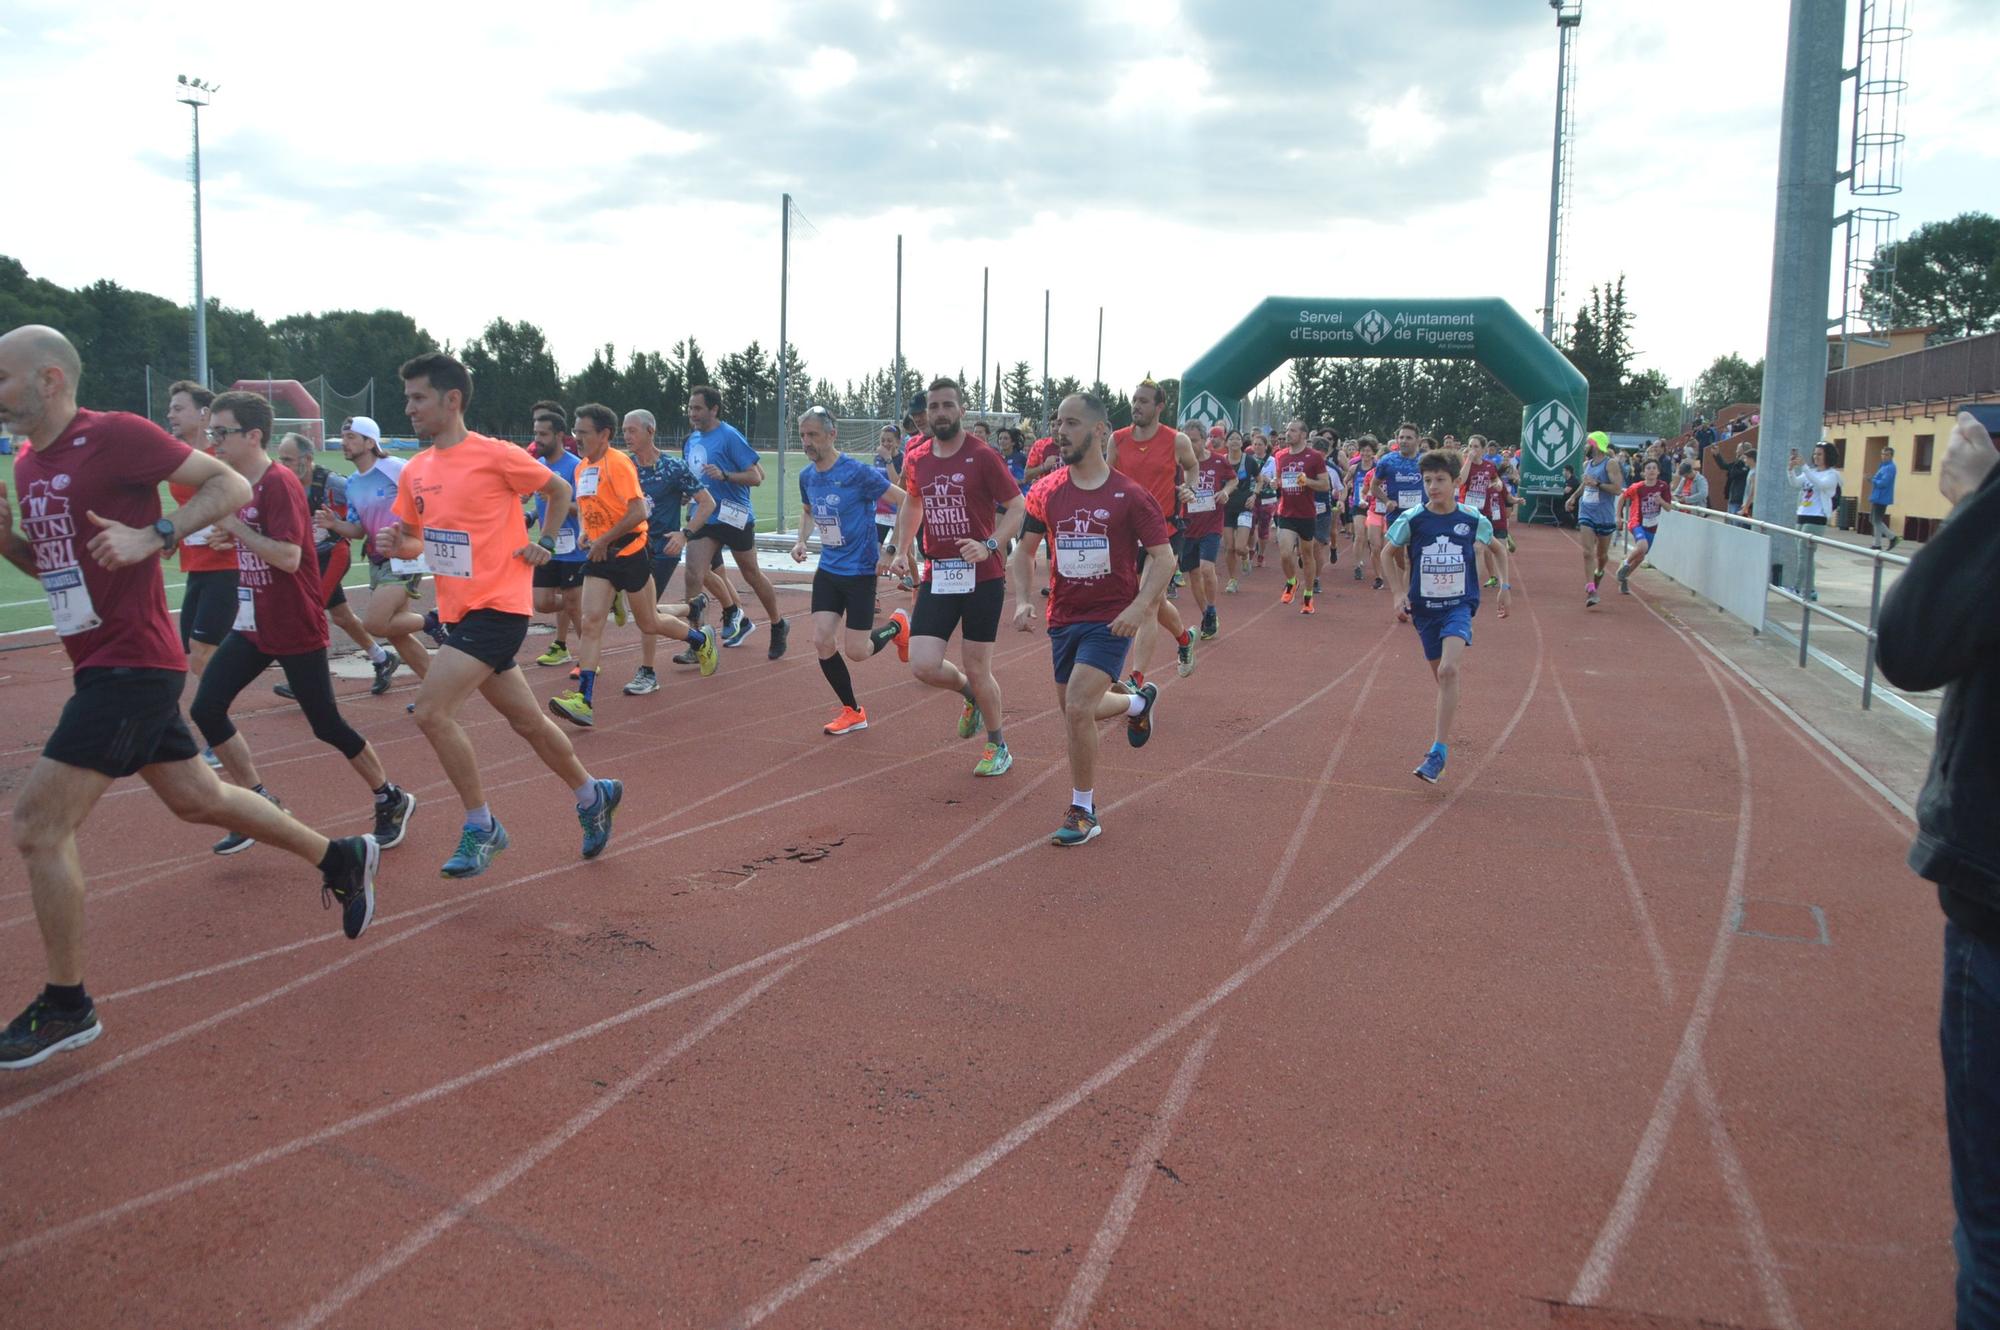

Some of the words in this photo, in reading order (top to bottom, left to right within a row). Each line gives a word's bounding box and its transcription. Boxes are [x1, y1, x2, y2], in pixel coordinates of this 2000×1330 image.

[1299, 310, 1343, 324] Servei
[1394, 312, 1475, 327] Ajuntament
[1290, 327, 1354, 342] d'Esports
[1393, 327, 1412, 340] de
[1416, 328, 1475, 344] Figueres
[935, 484, 949, 496] XV
[30, 497, 48, 517] XV
[924, 498, 963, 508] RUN
[925, 507, 969, 525] CASTELL
[1075, 519, 1090, 533] XV
[434, 543, 457, 559] 181
[1438, 543, 1448, 553] XI
[1078, 550, 1086, 562] 5
[1423, 556, 1461, 564] RUN
[944, 569, 964, 581] 166
[1432, 574, 1456, 585] 331
